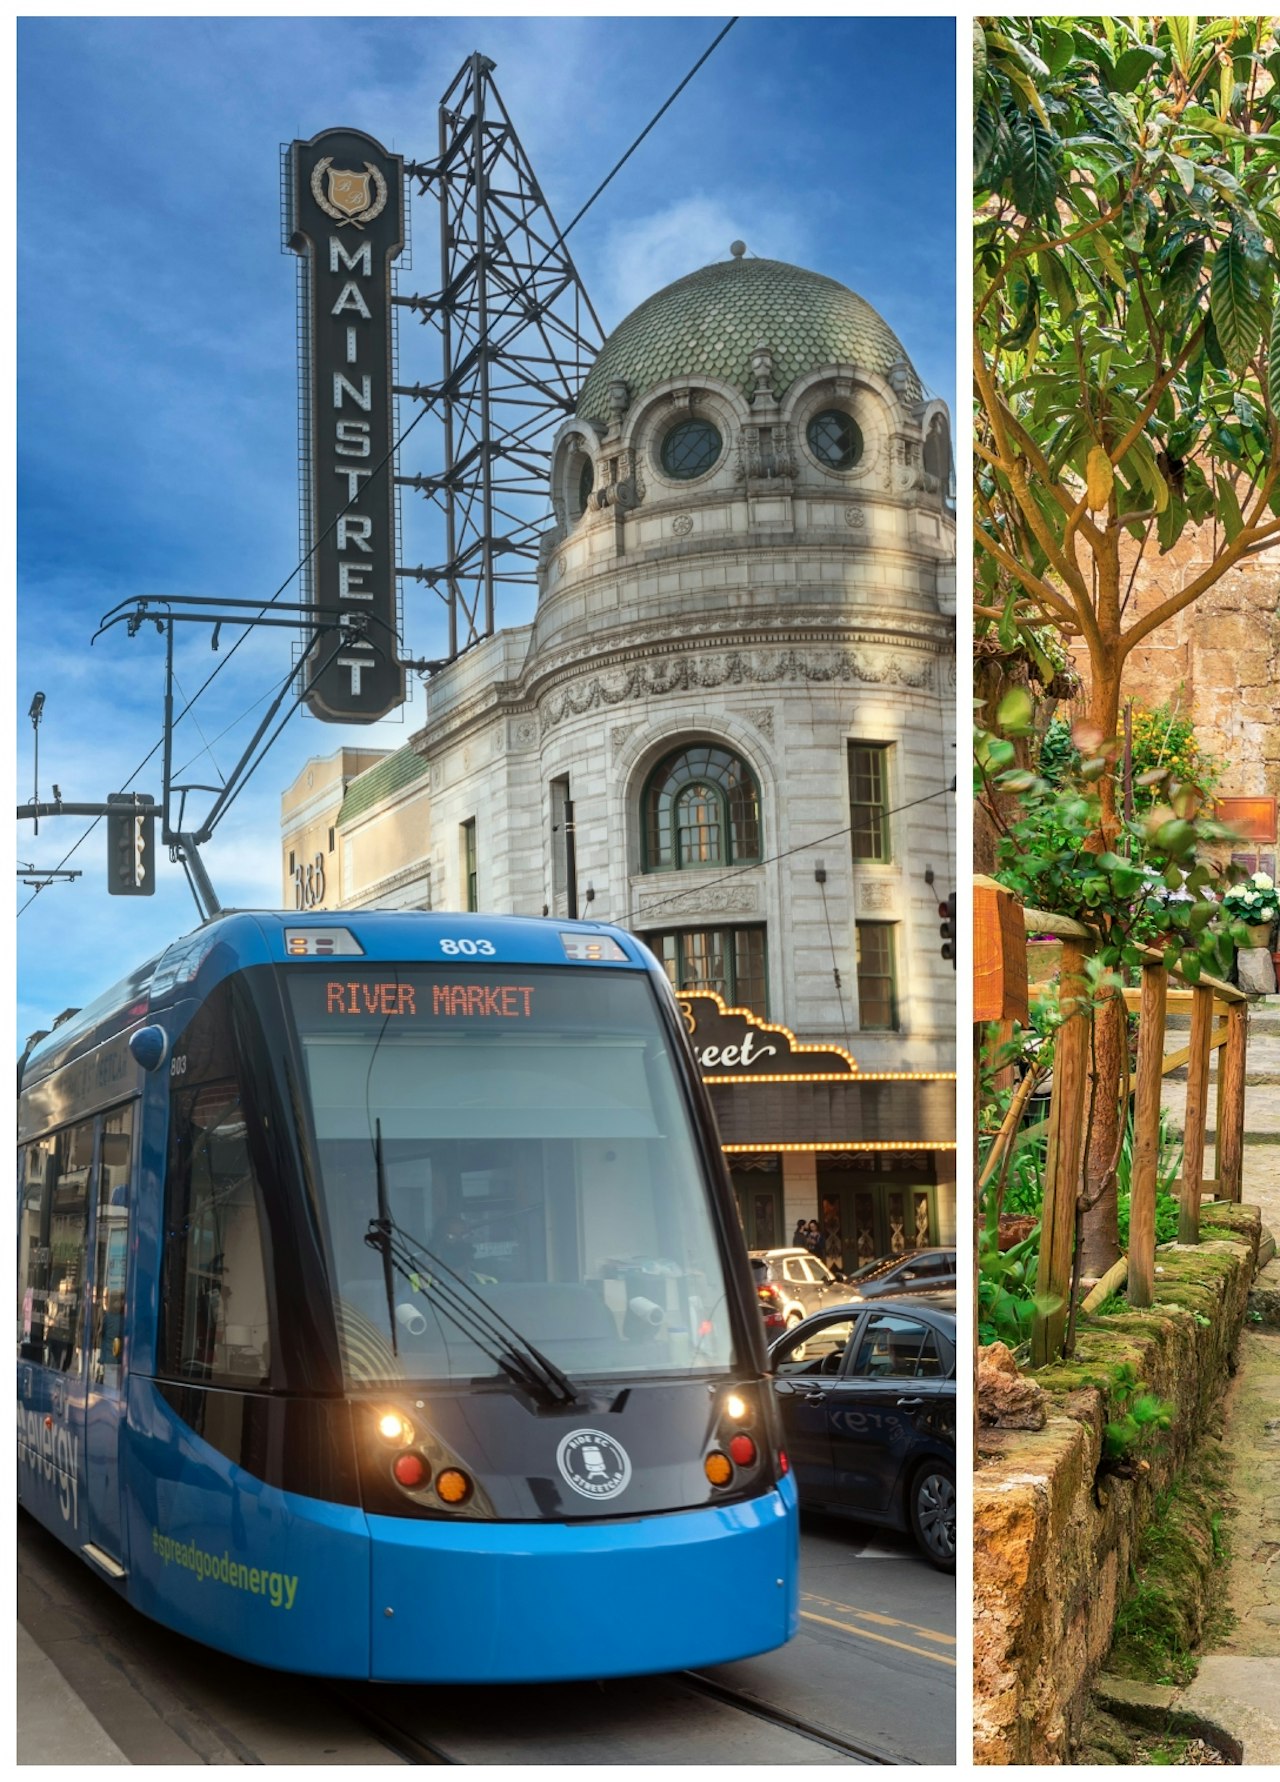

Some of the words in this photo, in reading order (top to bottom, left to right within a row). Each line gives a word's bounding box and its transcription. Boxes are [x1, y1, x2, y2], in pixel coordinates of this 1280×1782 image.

[440, 938, 496, 956] 803
[326, 982, 416, 1015] RIVER
[432, 984, 535, 1017] MARKET
[170, 1054, 187, 1077] 803
[568, 1435, 593, 1450] RIDE
[594, 1436, 610, 1448] KC
[572, 1472, 624, 1493] STREETCAR
[151, 1525, 299, 1610] #spreadgoodenergy
